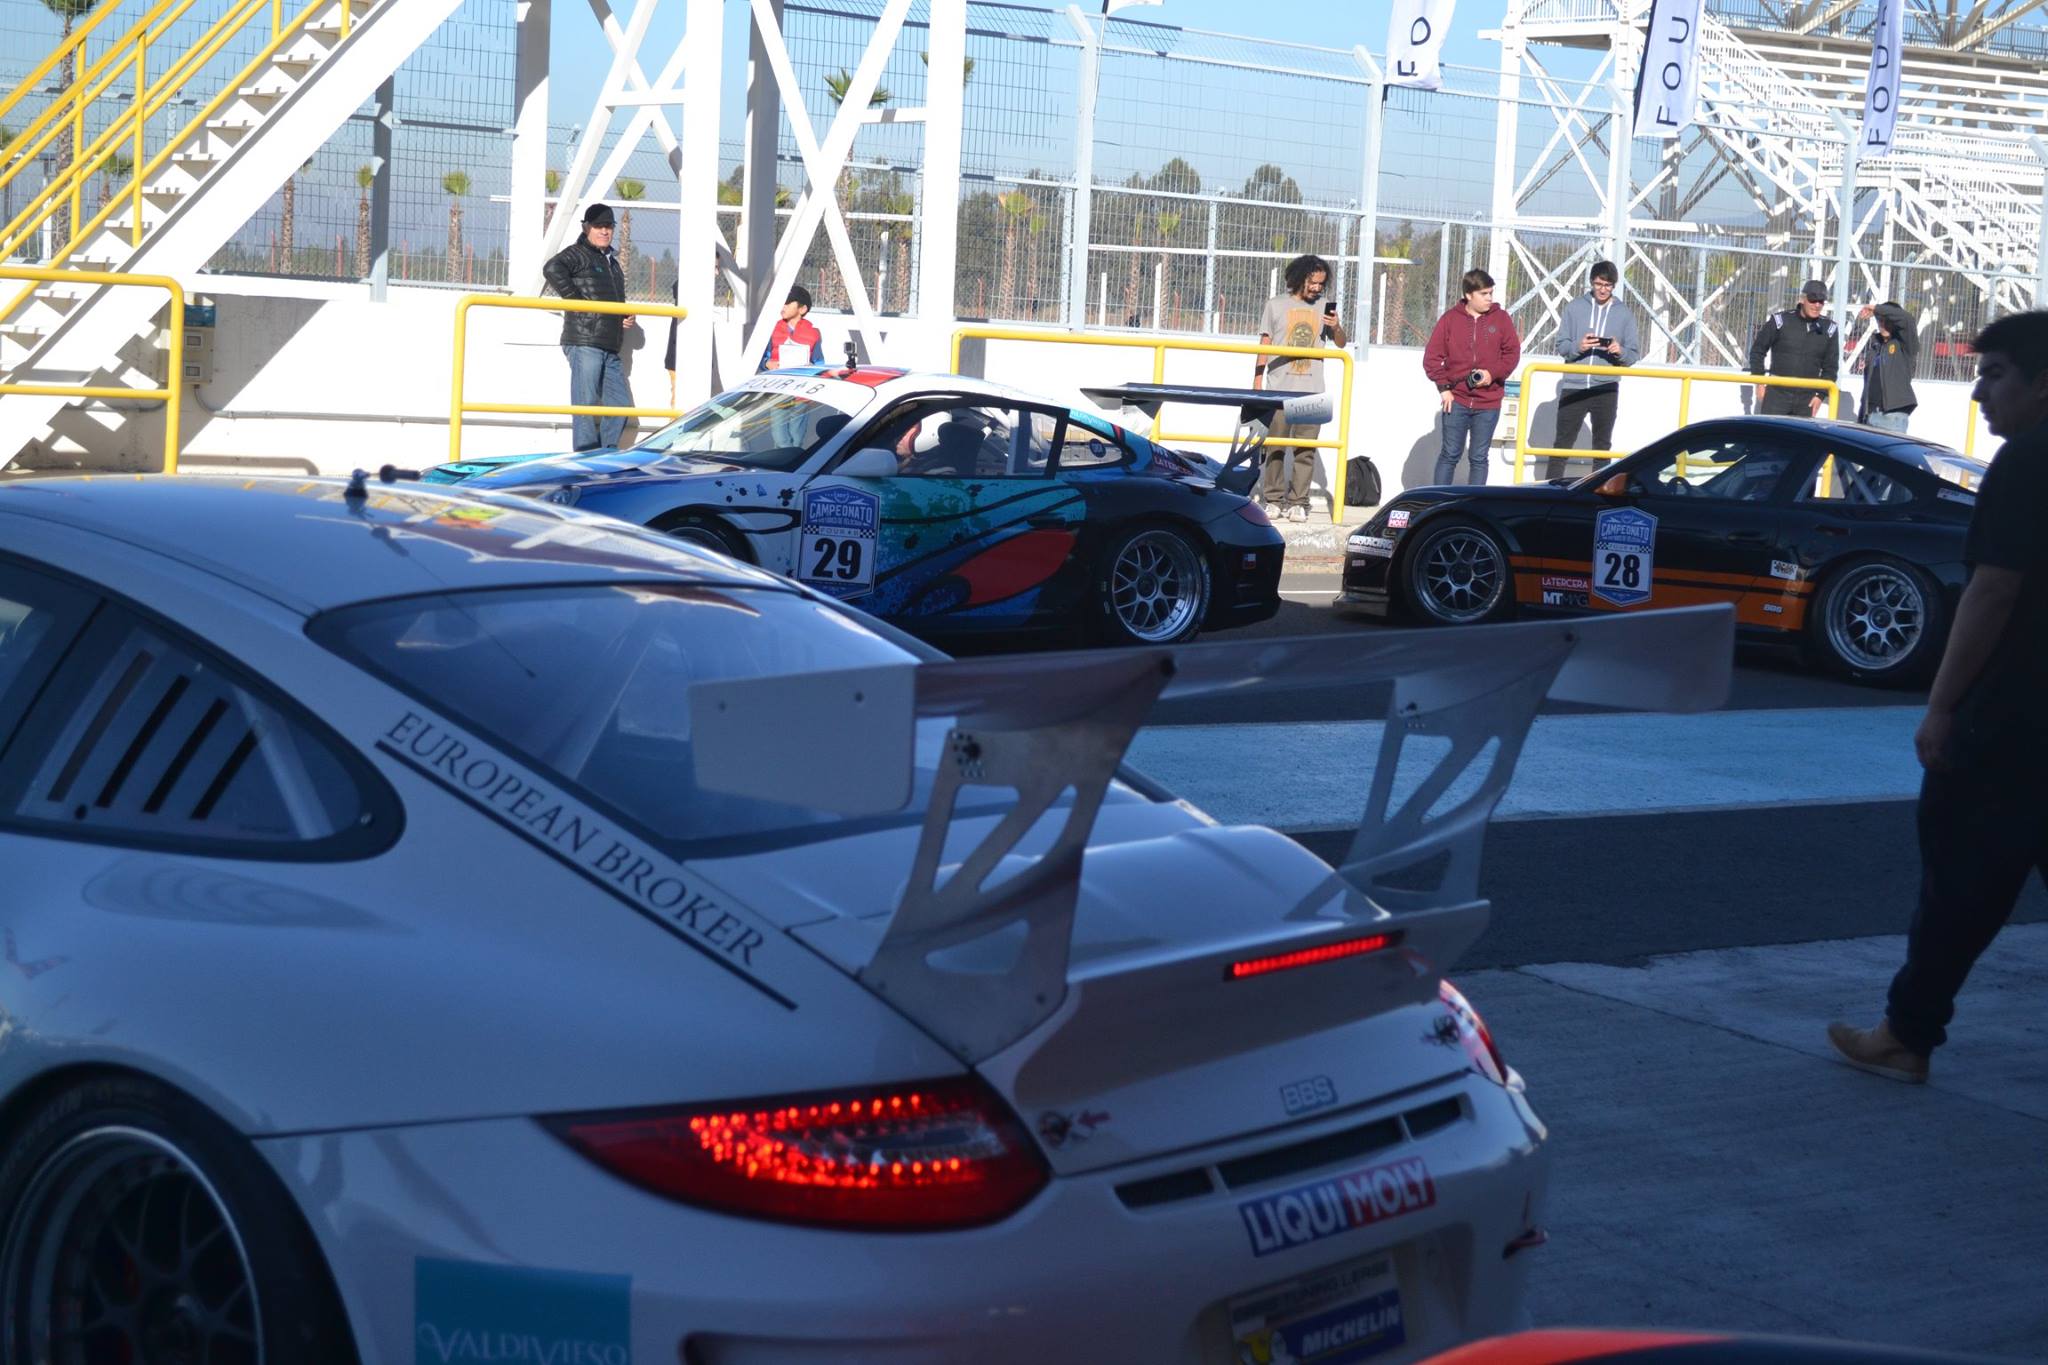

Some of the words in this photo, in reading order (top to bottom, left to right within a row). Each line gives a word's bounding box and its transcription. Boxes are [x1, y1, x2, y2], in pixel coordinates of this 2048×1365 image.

[1656, 16, 1690, 127] FOU
[809, 503, 873, 524] CAMPEONATO
[1600, 522, 1649, 540] CAMPEONATO
[812, 537, 862, 580] 29
[1603, 552, 1640, 588] 28
[385, 711, 599, 854] EUROPEAN
[593, 841, 764, 966] BROKER
[1282, 1076, 1334, 1116] BBS
[1245, 1182, 1348, 1252] LIQUI
[1343, 1160, 1430, 1223] MOLY
[416, 1321, 628, 1365] VALDIVIESO
[1301, 1303, 1401, 1357] MICHELIN
